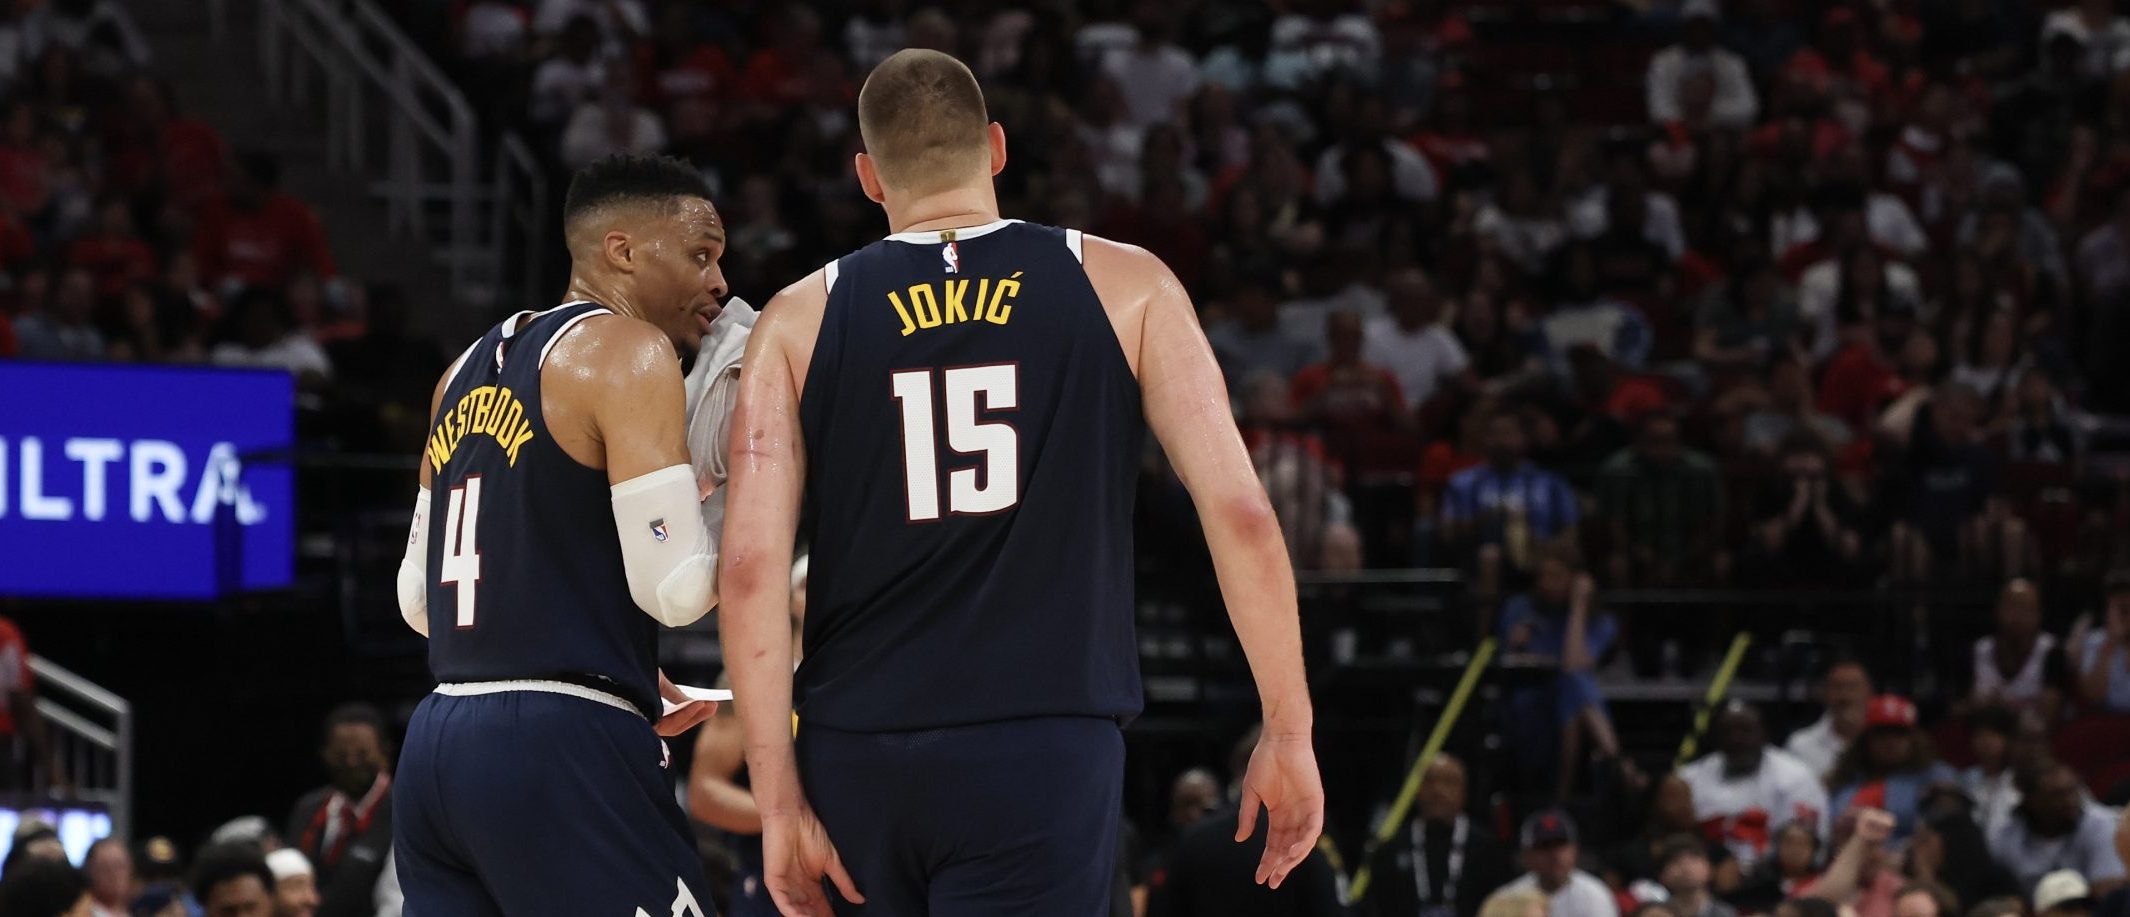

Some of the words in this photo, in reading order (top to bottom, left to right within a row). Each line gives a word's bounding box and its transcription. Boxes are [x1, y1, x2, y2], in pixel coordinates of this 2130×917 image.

[887, 271, 1024, 337] JOKIĆ
[427, 384, 534, 476] WESTBOOK
[889, 361, 1020, 524] 15
[0, 435, 266, 525] LTRA
[439, 472, 484, 630] 4
